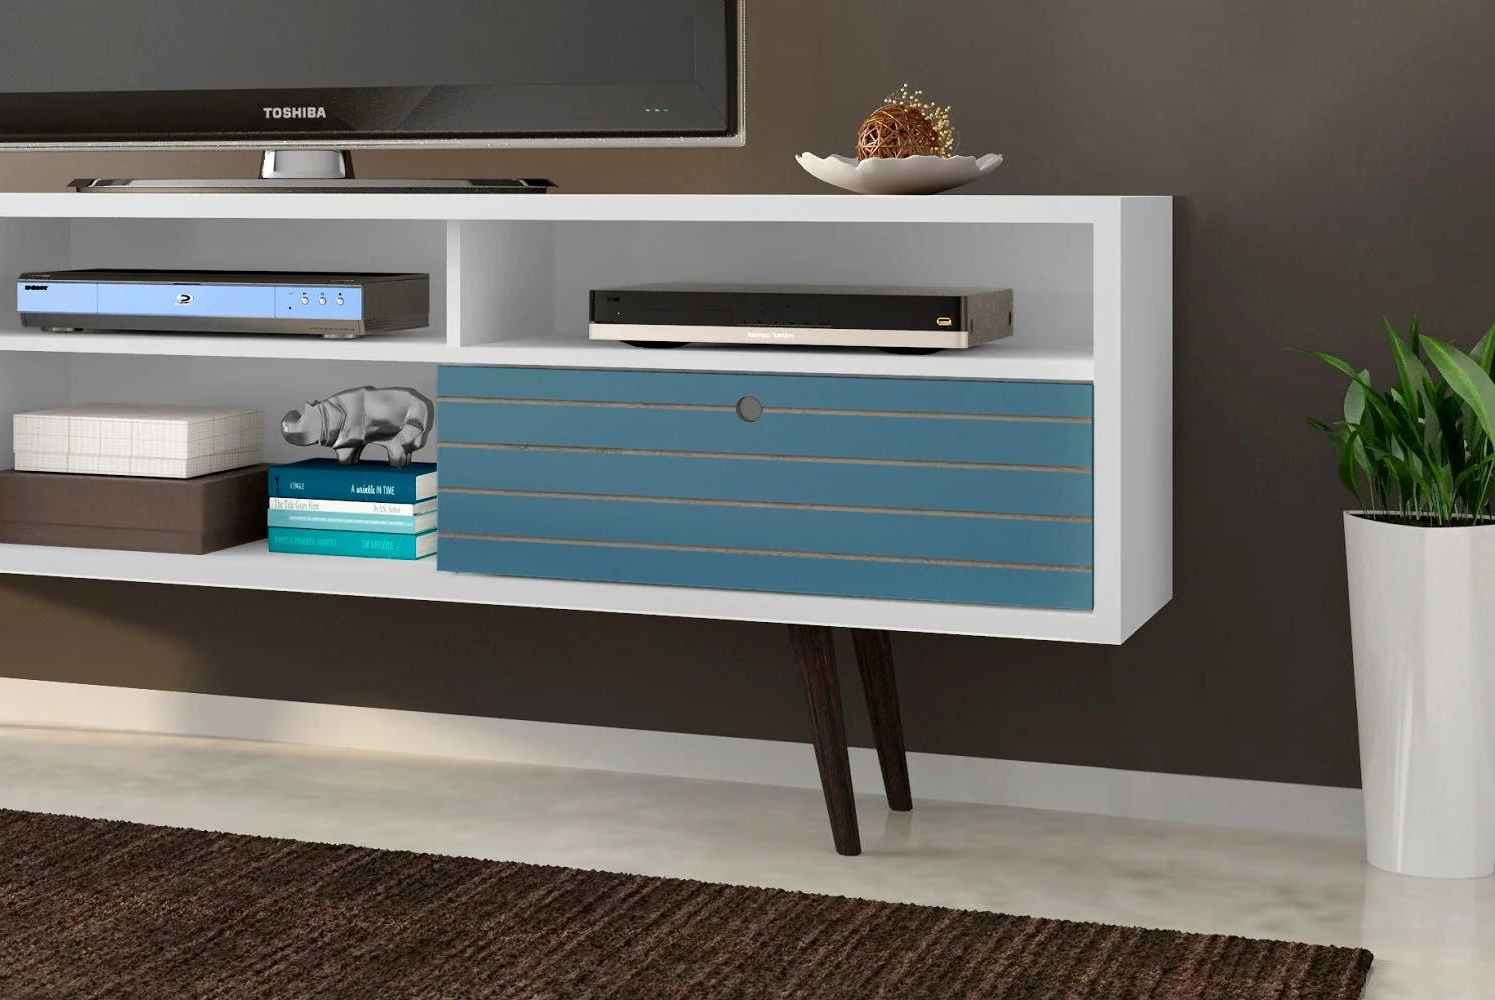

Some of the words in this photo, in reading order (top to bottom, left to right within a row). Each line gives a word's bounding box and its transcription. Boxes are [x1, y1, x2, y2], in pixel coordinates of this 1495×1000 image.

[263, 107, 326, 118] TOSHIBA
[351, 484, 355, 493] A
[376, 486, 382, 494] IN
[383, 486, 395, 495] TIME
[274, 499, 283, 508] The
